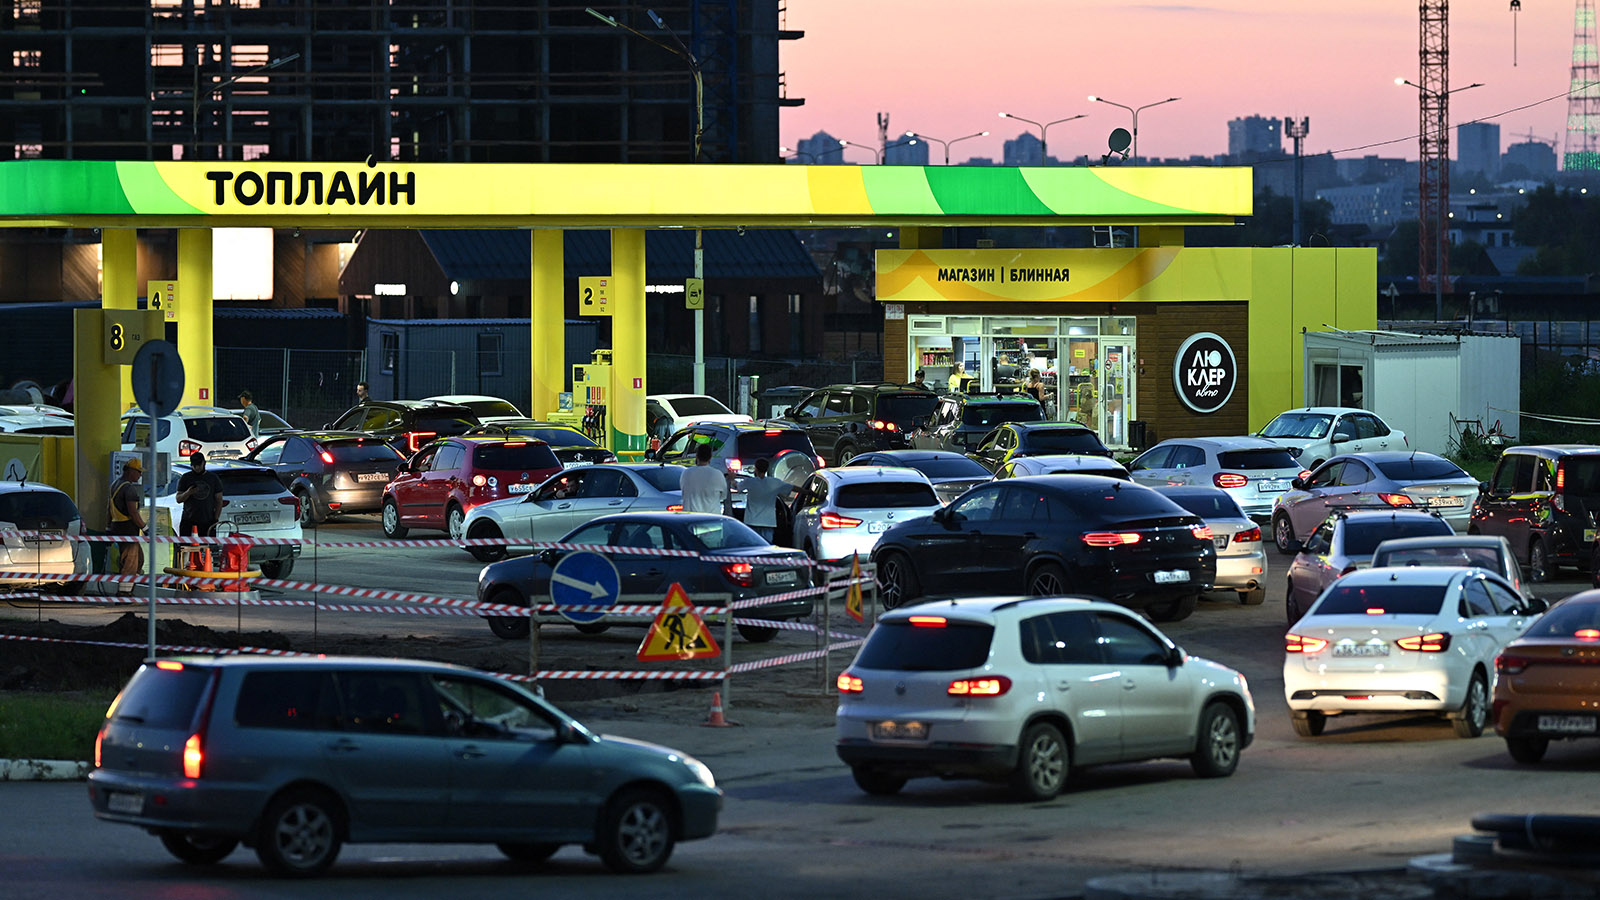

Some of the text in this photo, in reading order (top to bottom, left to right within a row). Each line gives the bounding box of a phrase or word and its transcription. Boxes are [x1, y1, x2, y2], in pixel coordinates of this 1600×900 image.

[206, 154, 416, 206] ТОПЛАЙН
[938, 268, 1070, 282] МАГАЗИН БЛИННАЯ
[152, 291, 162, 310] 4
[584, 287, 594, 305] 2
[110, 324, 123, 351] 8
[1191, 350, 1222, 367] ЛЮ
[1187, 368, 1226, 386] КЛЕР
[1195, 382, 1219, 397] авто
